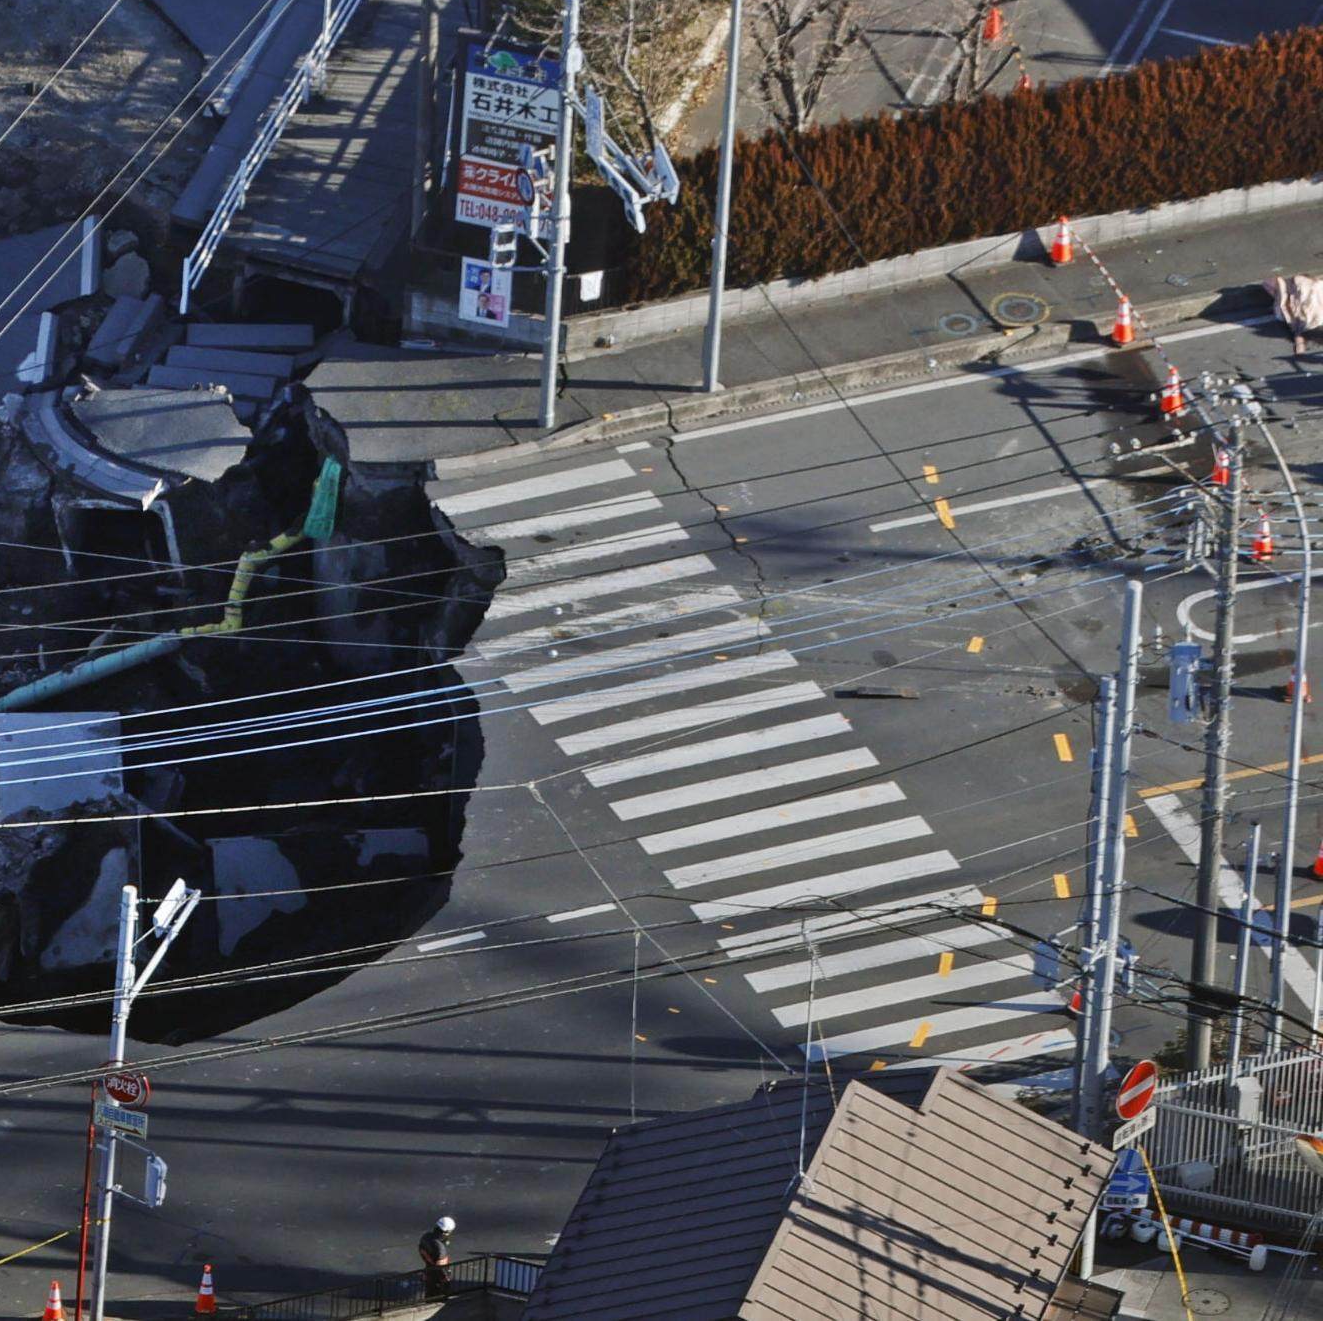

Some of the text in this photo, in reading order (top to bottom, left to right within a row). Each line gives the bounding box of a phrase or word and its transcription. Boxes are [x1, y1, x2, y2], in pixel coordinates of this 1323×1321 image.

[472, 76, 529, 99] 株式会社
[471, 92, 559, 126] 石井木工
[106, 1076, 139, 1097] 消火栓
